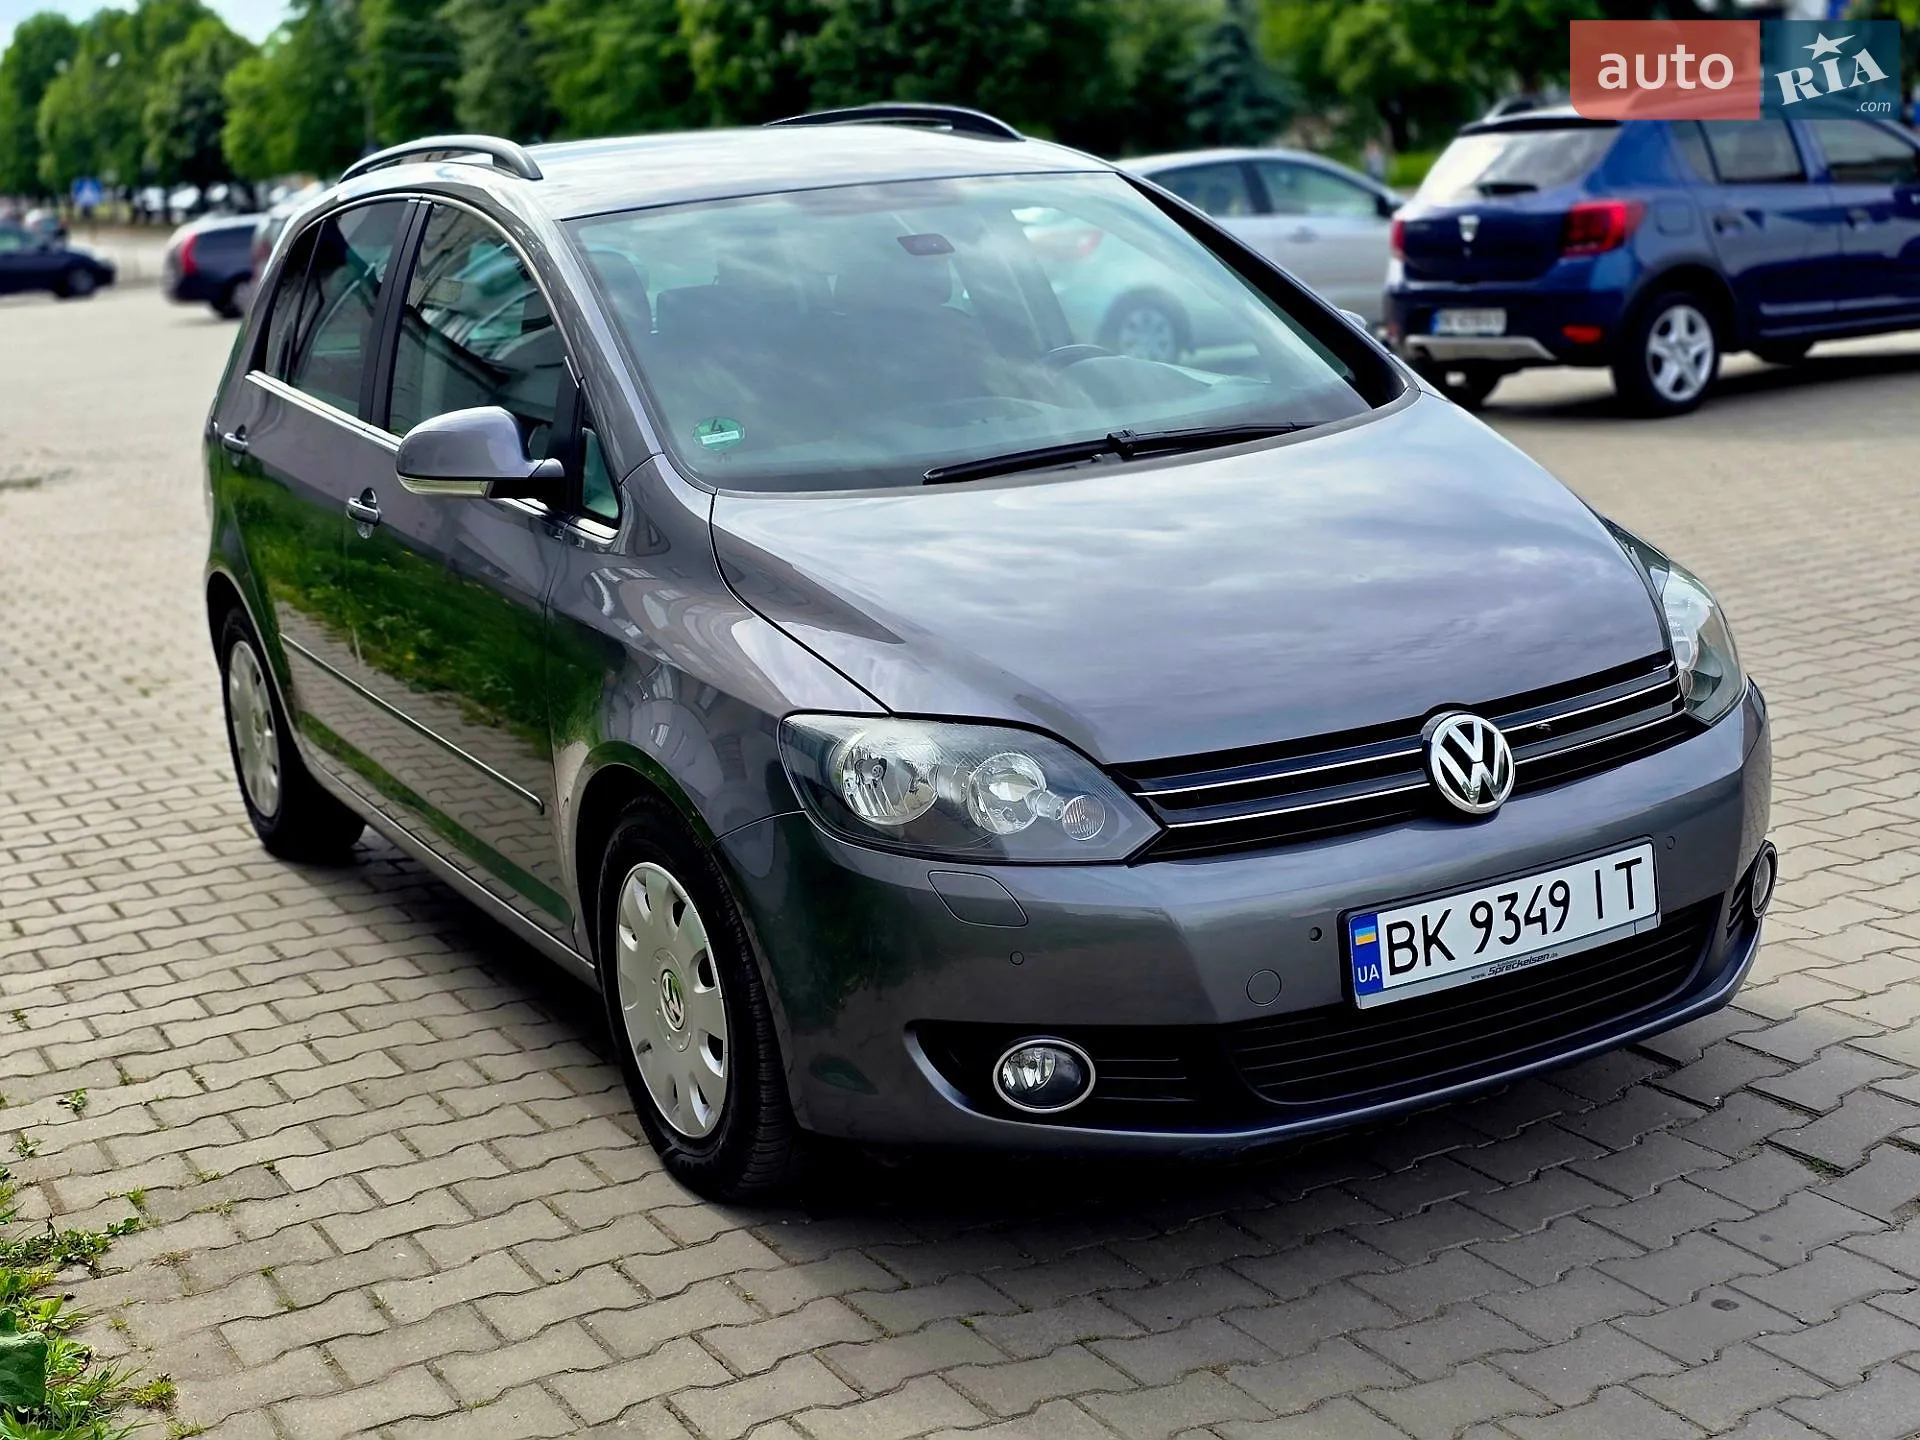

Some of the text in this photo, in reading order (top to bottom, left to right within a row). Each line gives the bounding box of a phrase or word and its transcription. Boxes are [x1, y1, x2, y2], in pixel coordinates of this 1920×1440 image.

[1385, 856, 1643, 977] BK 9349 IT
[1357, 963, 1380, 984] UA
